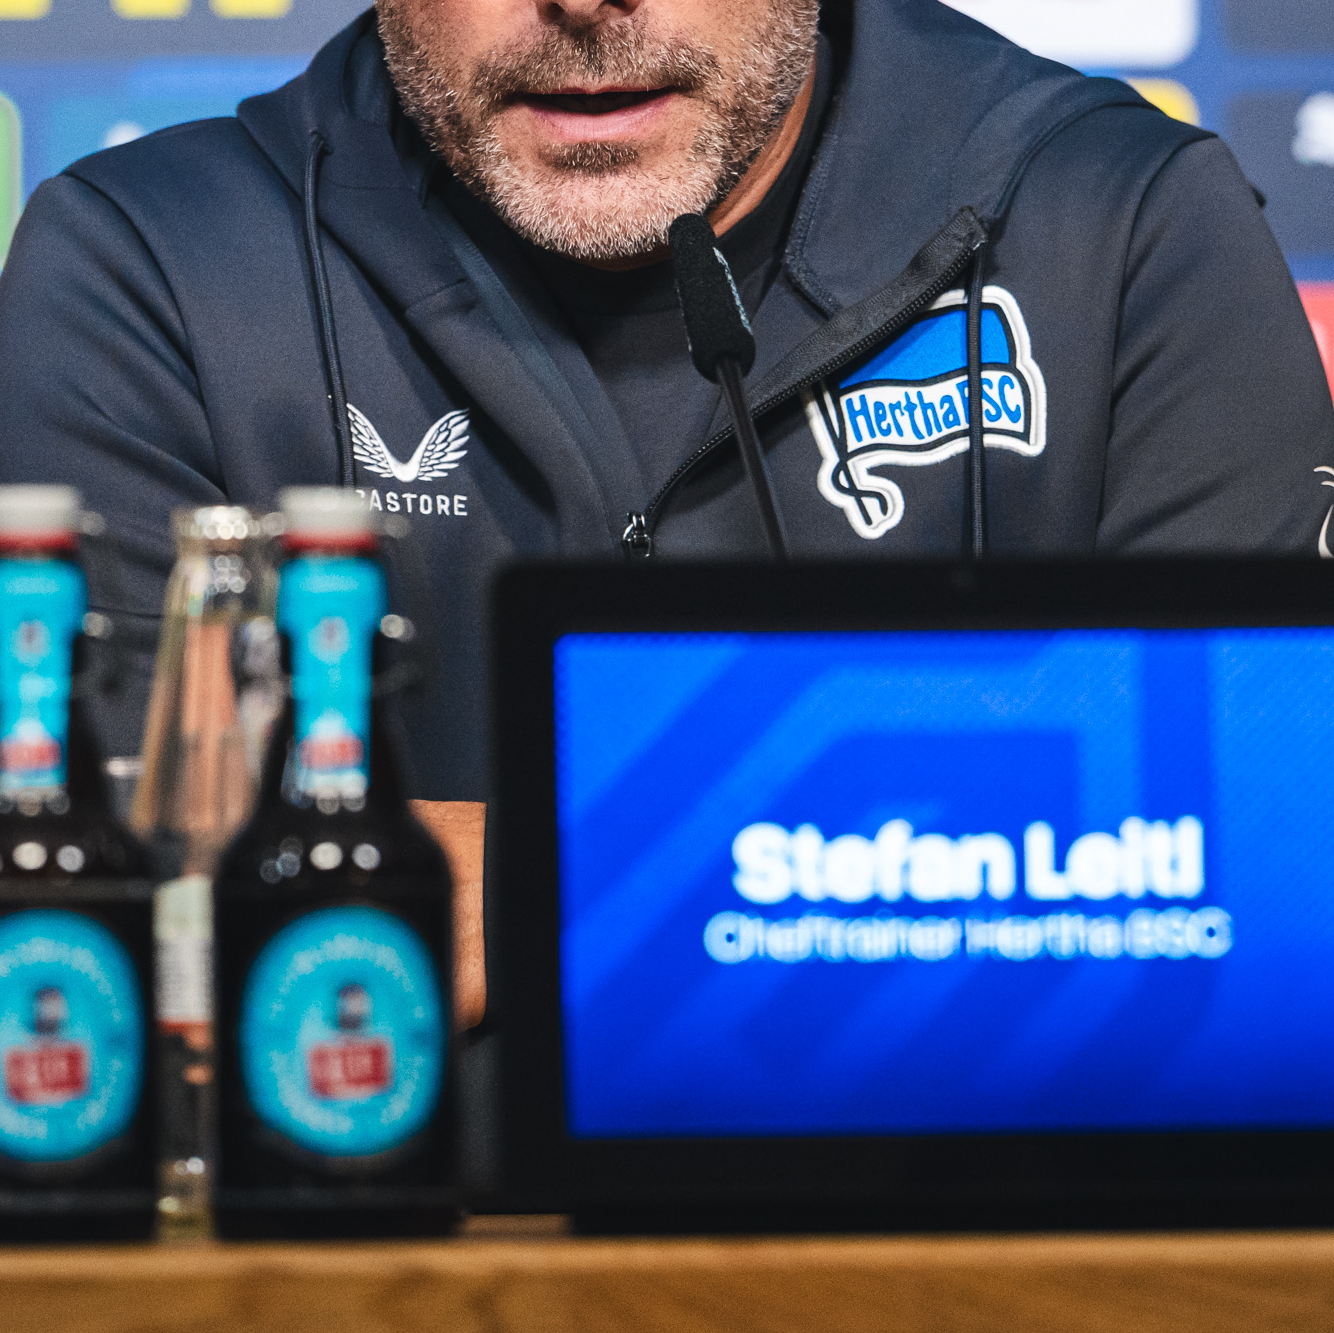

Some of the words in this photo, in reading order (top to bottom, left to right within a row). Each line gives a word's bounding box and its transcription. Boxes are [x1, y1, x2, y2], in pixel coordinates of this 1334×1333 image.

[731, 819, 1016, 904] Stefan
[1024, 815, 1204, 901] Leitl
[966, 910, 1124, 961] Hertha
[1124, 906, 1233, 960] BSC
